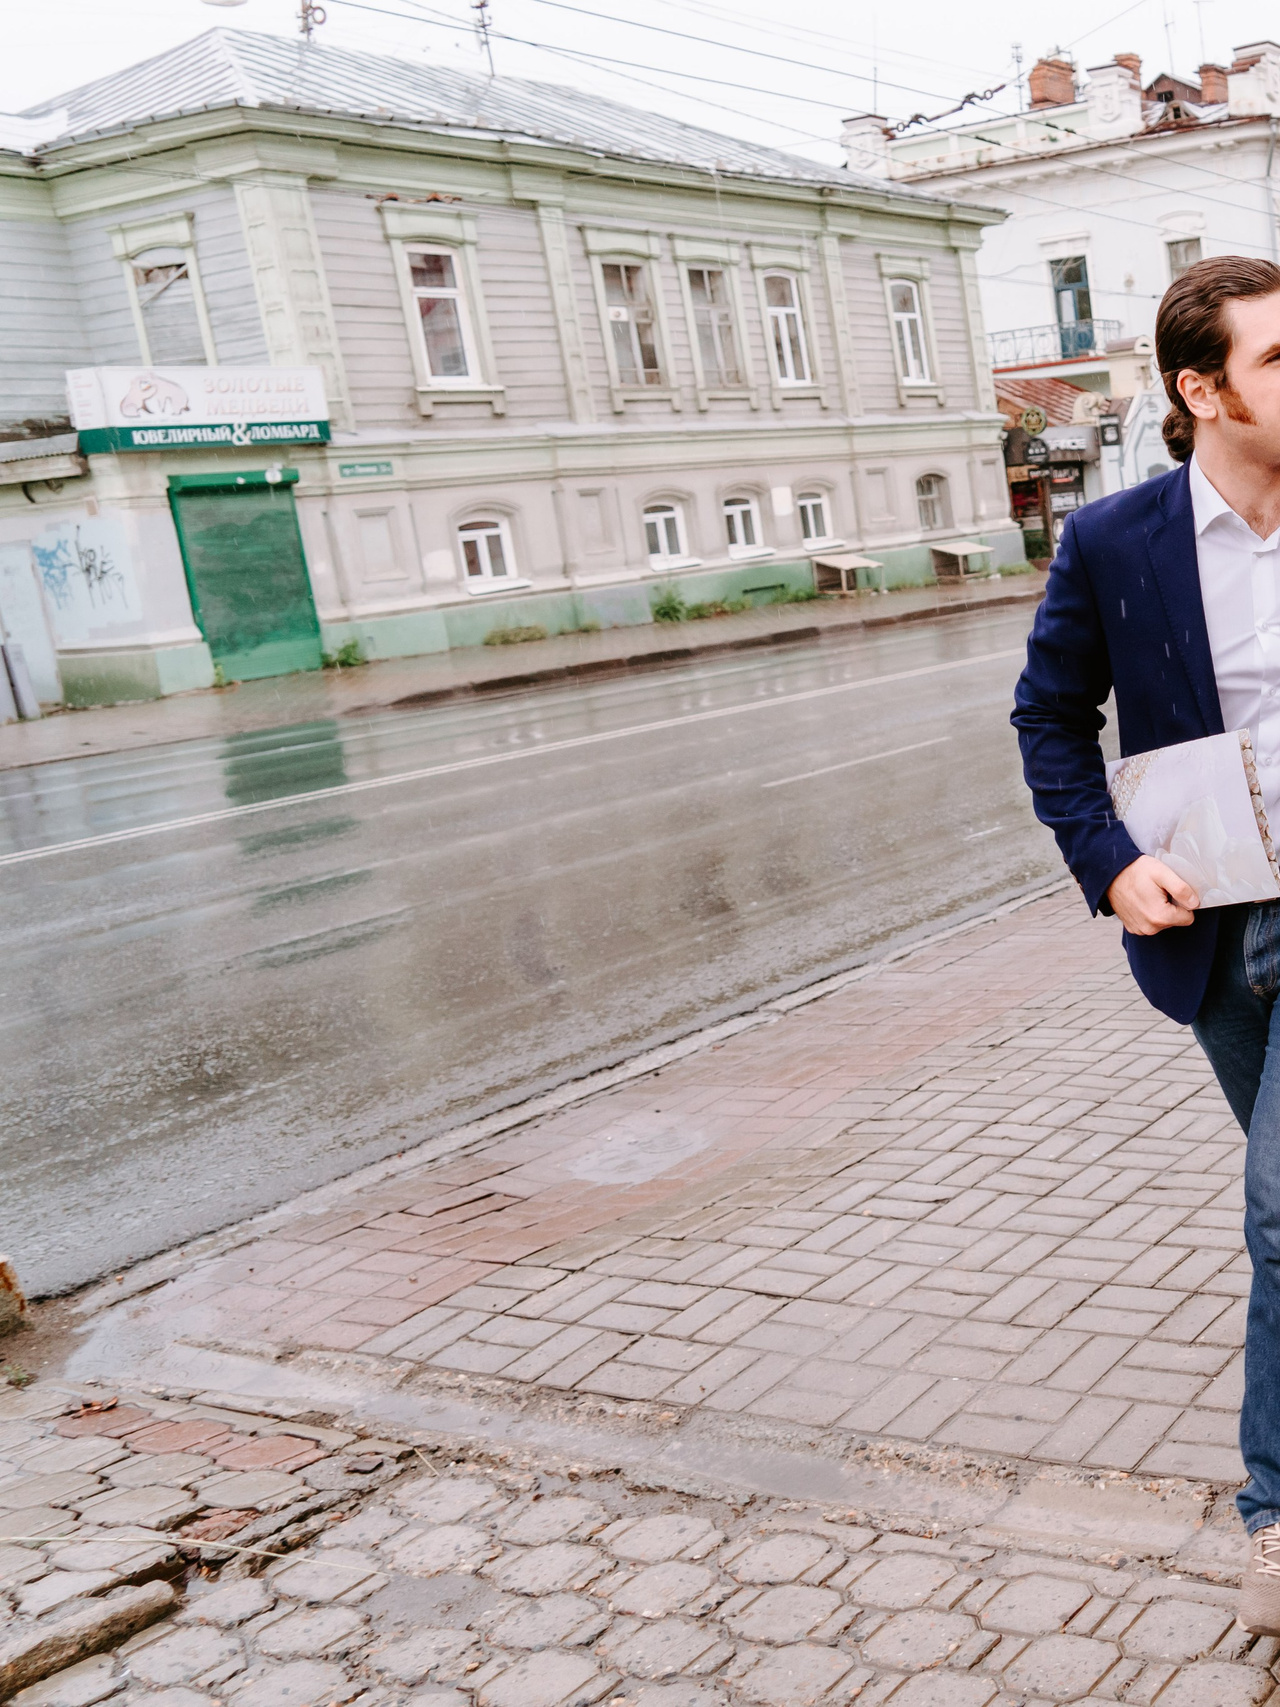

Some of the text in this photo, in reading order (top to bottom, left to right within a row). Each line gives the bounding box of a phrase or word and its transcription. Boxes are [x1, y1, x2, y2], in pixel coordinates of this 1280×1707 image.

[203, 376, 305, 393] ЗОЛОТЫЕ
[206, 397, 310, 417] МЕДВЕДИ
[132, 425, 231, 445] ЮВЕЛИРНЫЙ
[251, 424, 320, 440] ЛОМБАРД
